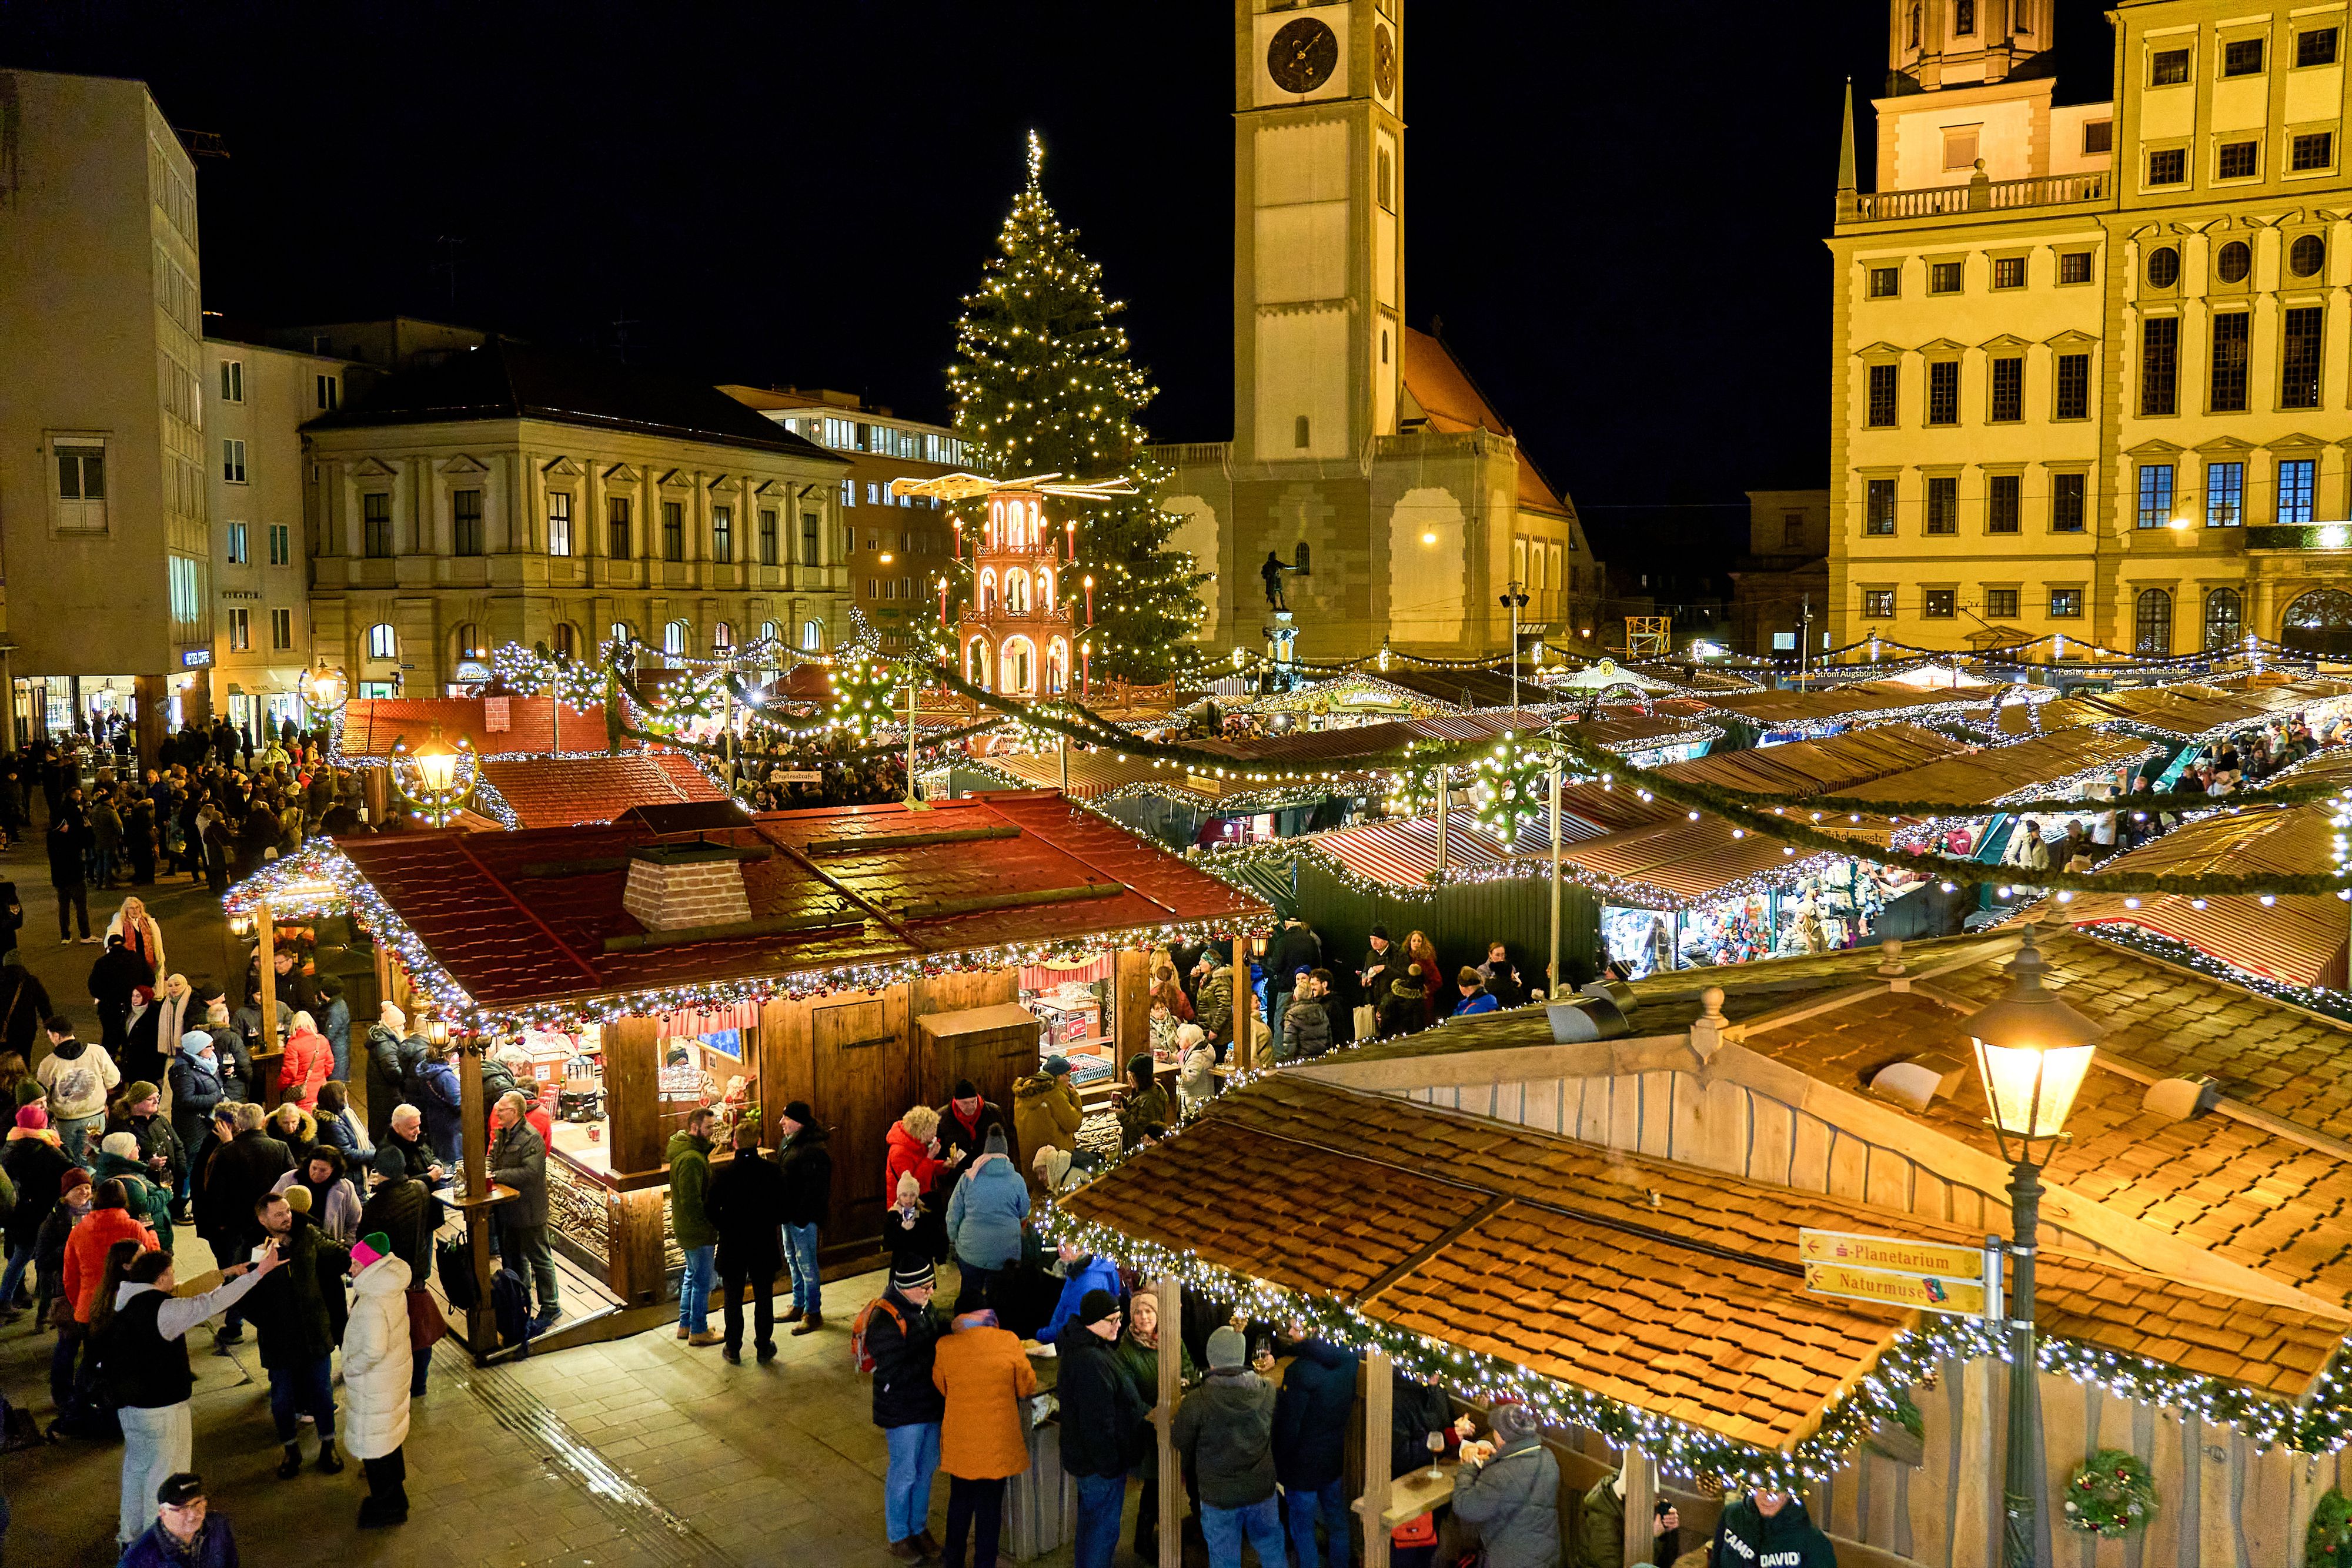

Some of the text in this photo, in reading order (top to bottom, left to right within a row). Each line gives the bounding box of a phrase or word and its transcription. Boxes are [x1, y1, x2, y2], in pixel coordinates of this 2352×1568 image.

[1840, 1273, 1950, 1303] Naturmuse
[1724, 1528, 1755, 1560] CAMP
[1760, 1552, 1800, 1568] DAVID
